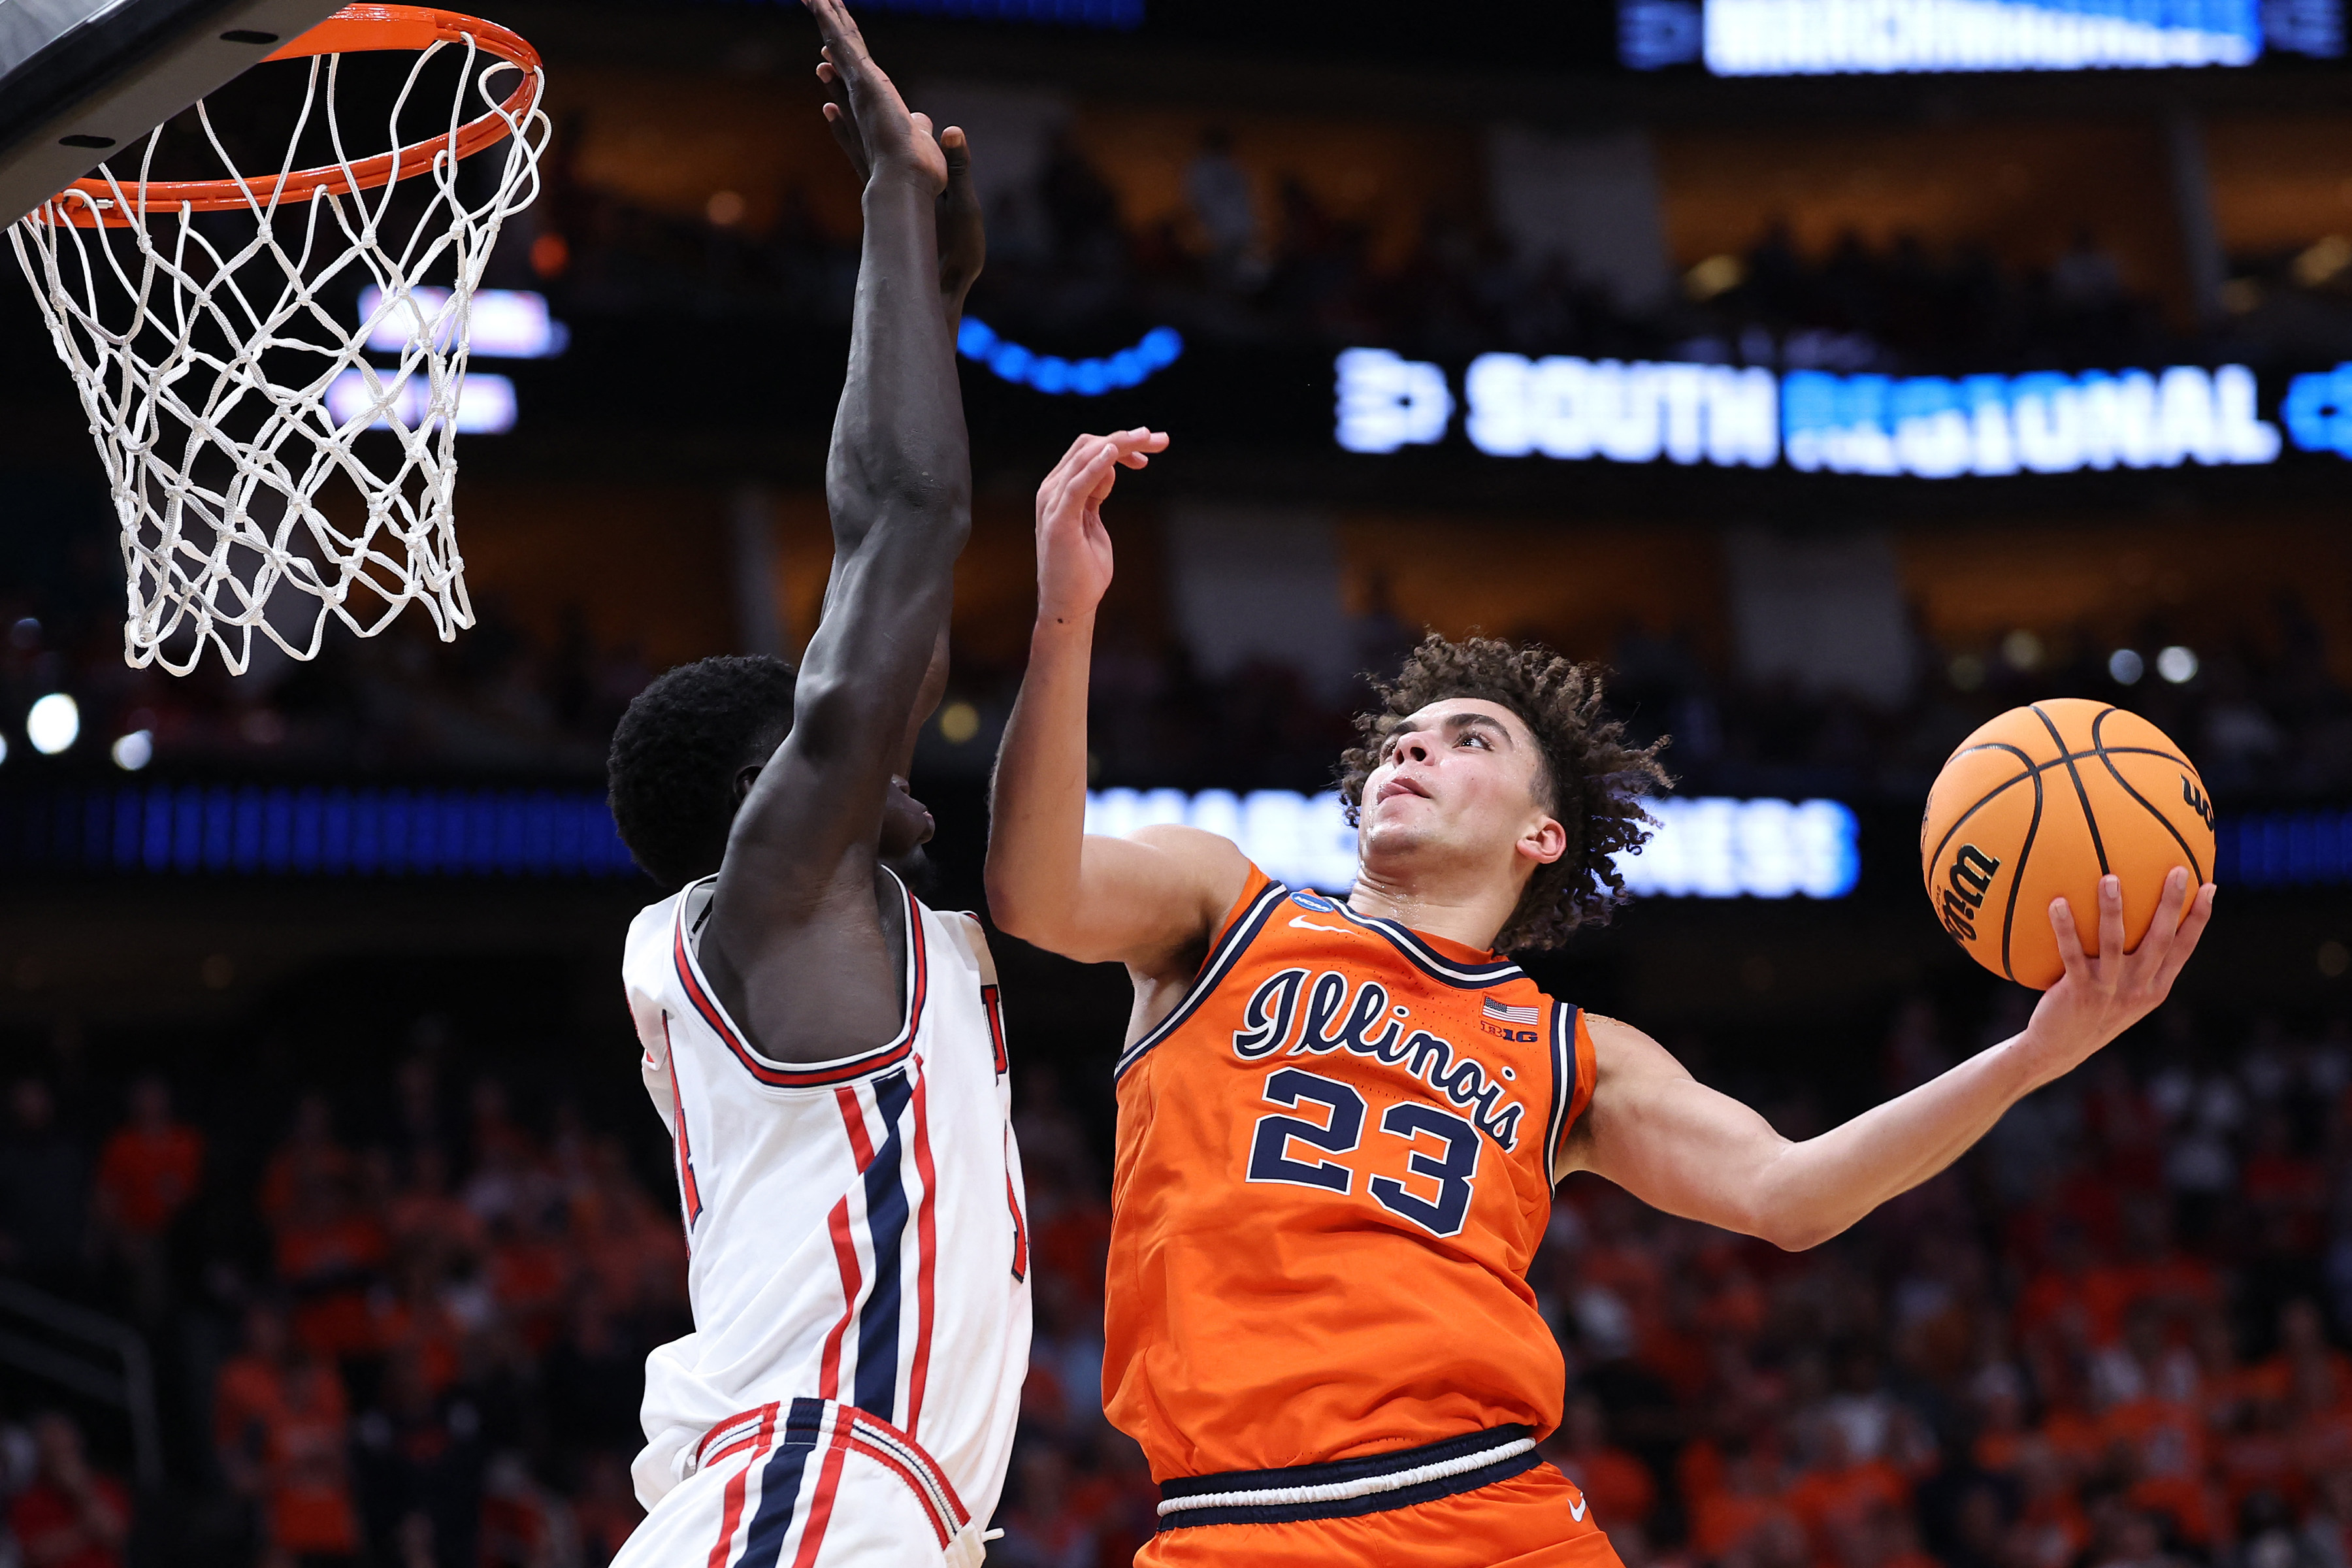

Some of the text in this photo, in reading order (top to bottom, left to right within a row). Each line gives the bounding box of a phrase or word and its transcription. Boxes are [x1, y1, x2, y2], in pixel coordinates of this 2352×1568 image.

[1465, 351, 1778, 468] SOUTH
[1294, 896, 1330, 911] NCAA
[1232, 968, 1525, 1154] Illinois
[1245, 1066, 1483, 1239] 23
